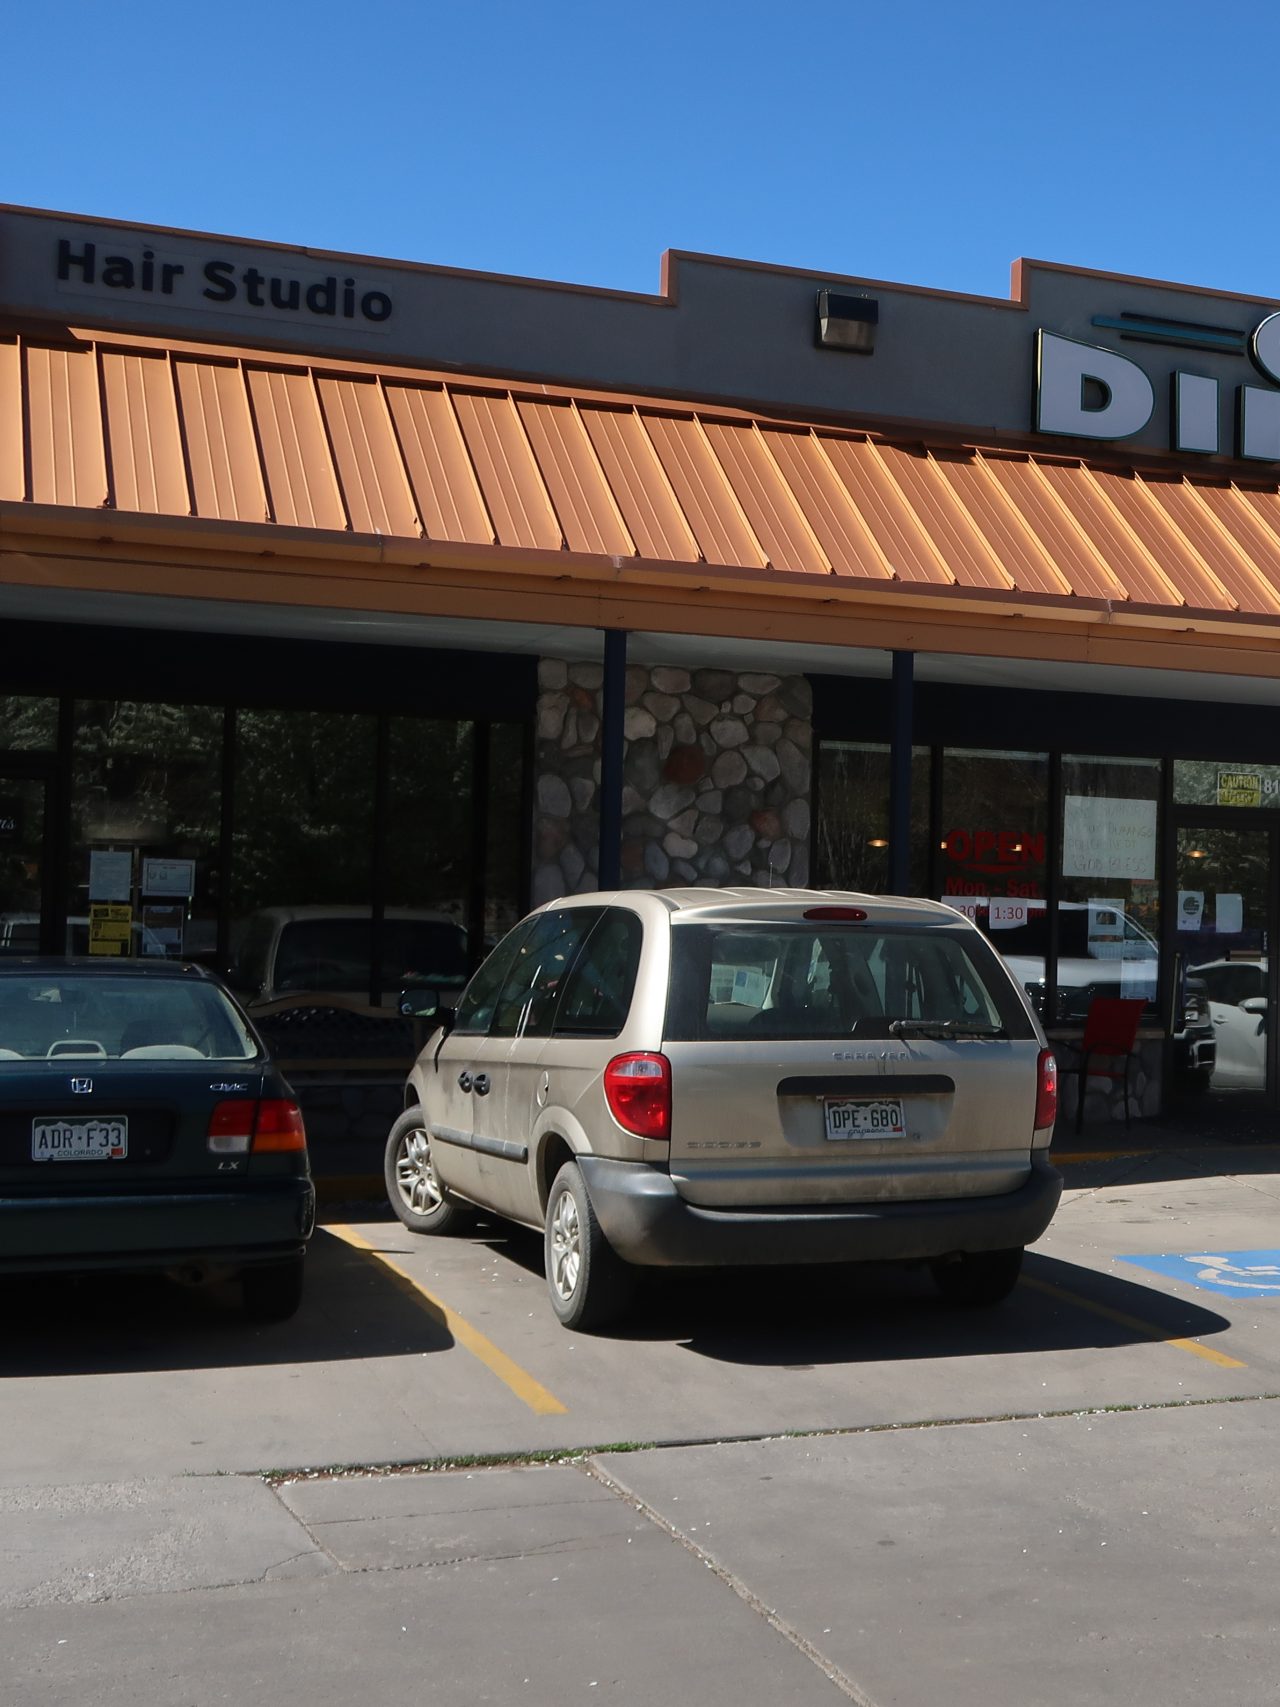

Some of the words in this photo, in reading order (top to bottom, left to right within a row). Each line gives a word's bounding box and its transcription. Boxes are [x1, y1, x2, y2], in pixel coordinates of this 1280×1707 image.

[57, 239, 183, 294] Hair
[203, 260, 393, 322] Studio
[1221, 774, 1258, 789] CAUTION
[947, 830, 1045, 864] OPEN
[994, 906, 1024, 920] 1:30
[57, 1149, 104, 1157] COLORADO
[217, 1161, 240, 1171] LX
